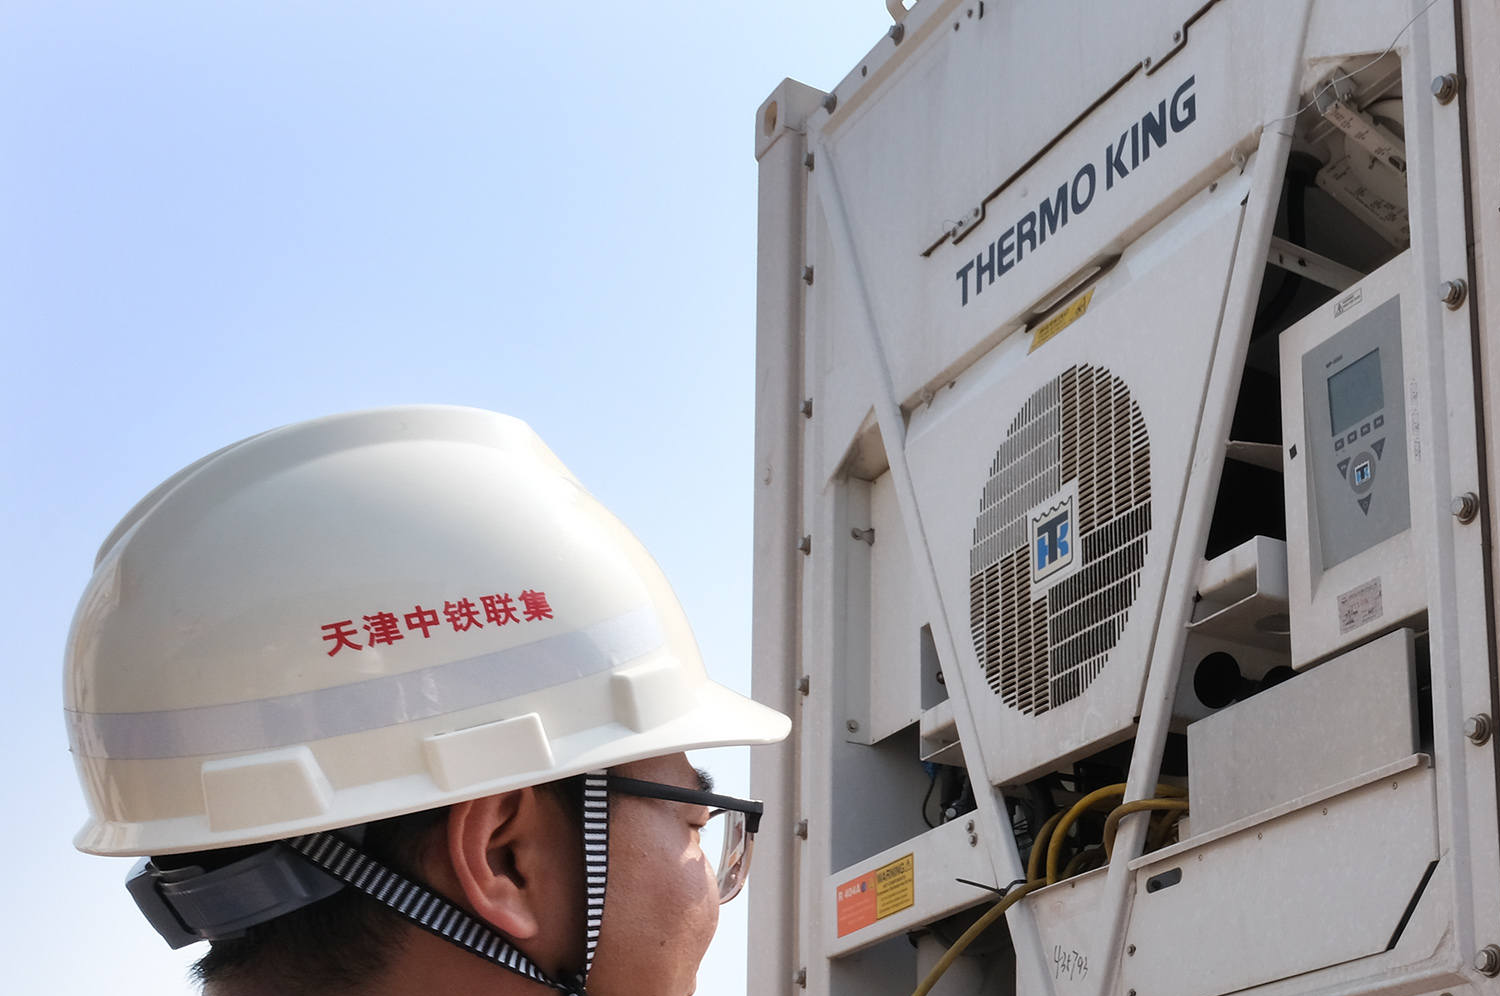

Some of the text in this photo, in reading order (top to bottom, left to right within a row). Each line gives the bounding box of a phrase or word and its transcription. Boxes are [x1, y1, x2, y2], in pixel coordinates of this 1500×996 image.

[956, 163, 1098, 307] THERMO
[1105, 75, 1198, 192] KING
[320, 589, 555, 657] 天津中铁联集
